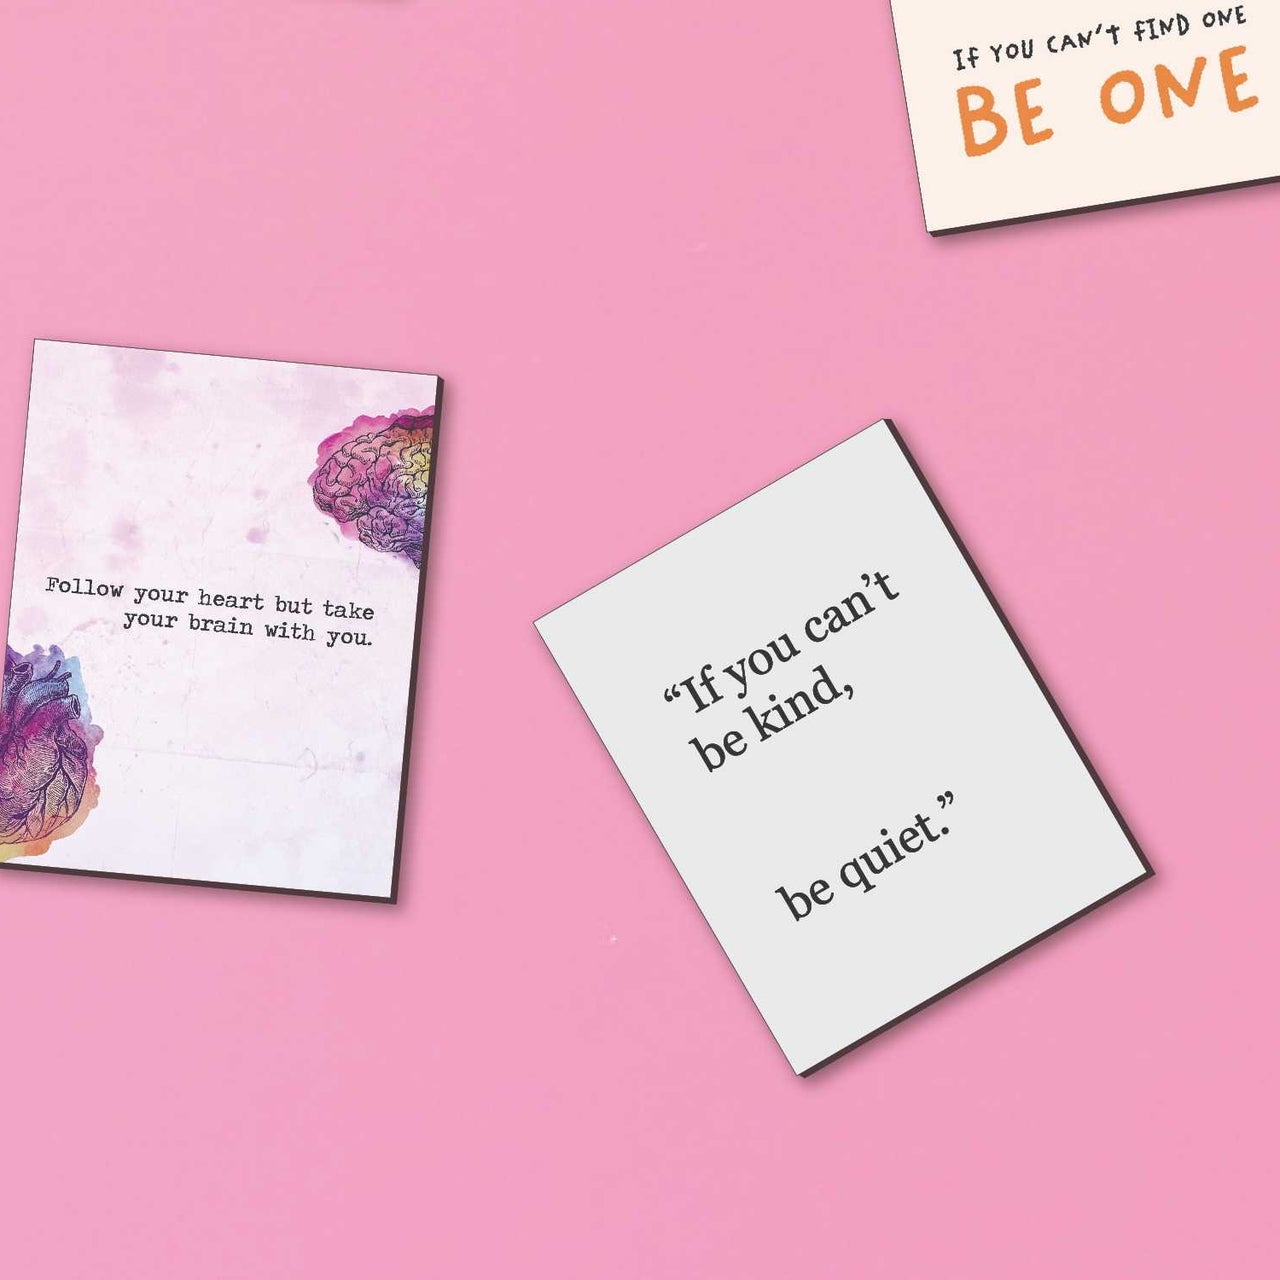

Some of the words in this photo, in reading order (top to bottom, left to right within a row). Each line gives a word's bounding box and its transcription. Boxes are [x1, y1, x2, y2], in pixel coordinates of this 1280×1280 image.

[953, 46, 979, 71] IF
[989, 38, 1034, 64] YOU
[1134, 12, 1190, 41] FIND
[1202, 5, 1247, 27] ONE
[956, 77, 1054, 157] BE
[1100, 45, 1259, 125] ONE
[45, 576, 125, 598] Follow
[133, 585, 189, 607] your
[198, 589, 264, 611] heart
[274, 594, 313, 616] but
[322, 599, 375, 621] take
[122, 610, 178, 631] your
[189, 613, 253, 636] brain
[265, 620, 316, 641] with
[326, 627, 372, 648] you.
[722, 632, 801, 699] you
[688, 723, 748, 773] be
[742, 664, 854, 742] kind,
[775, 873, 835, 922] be
